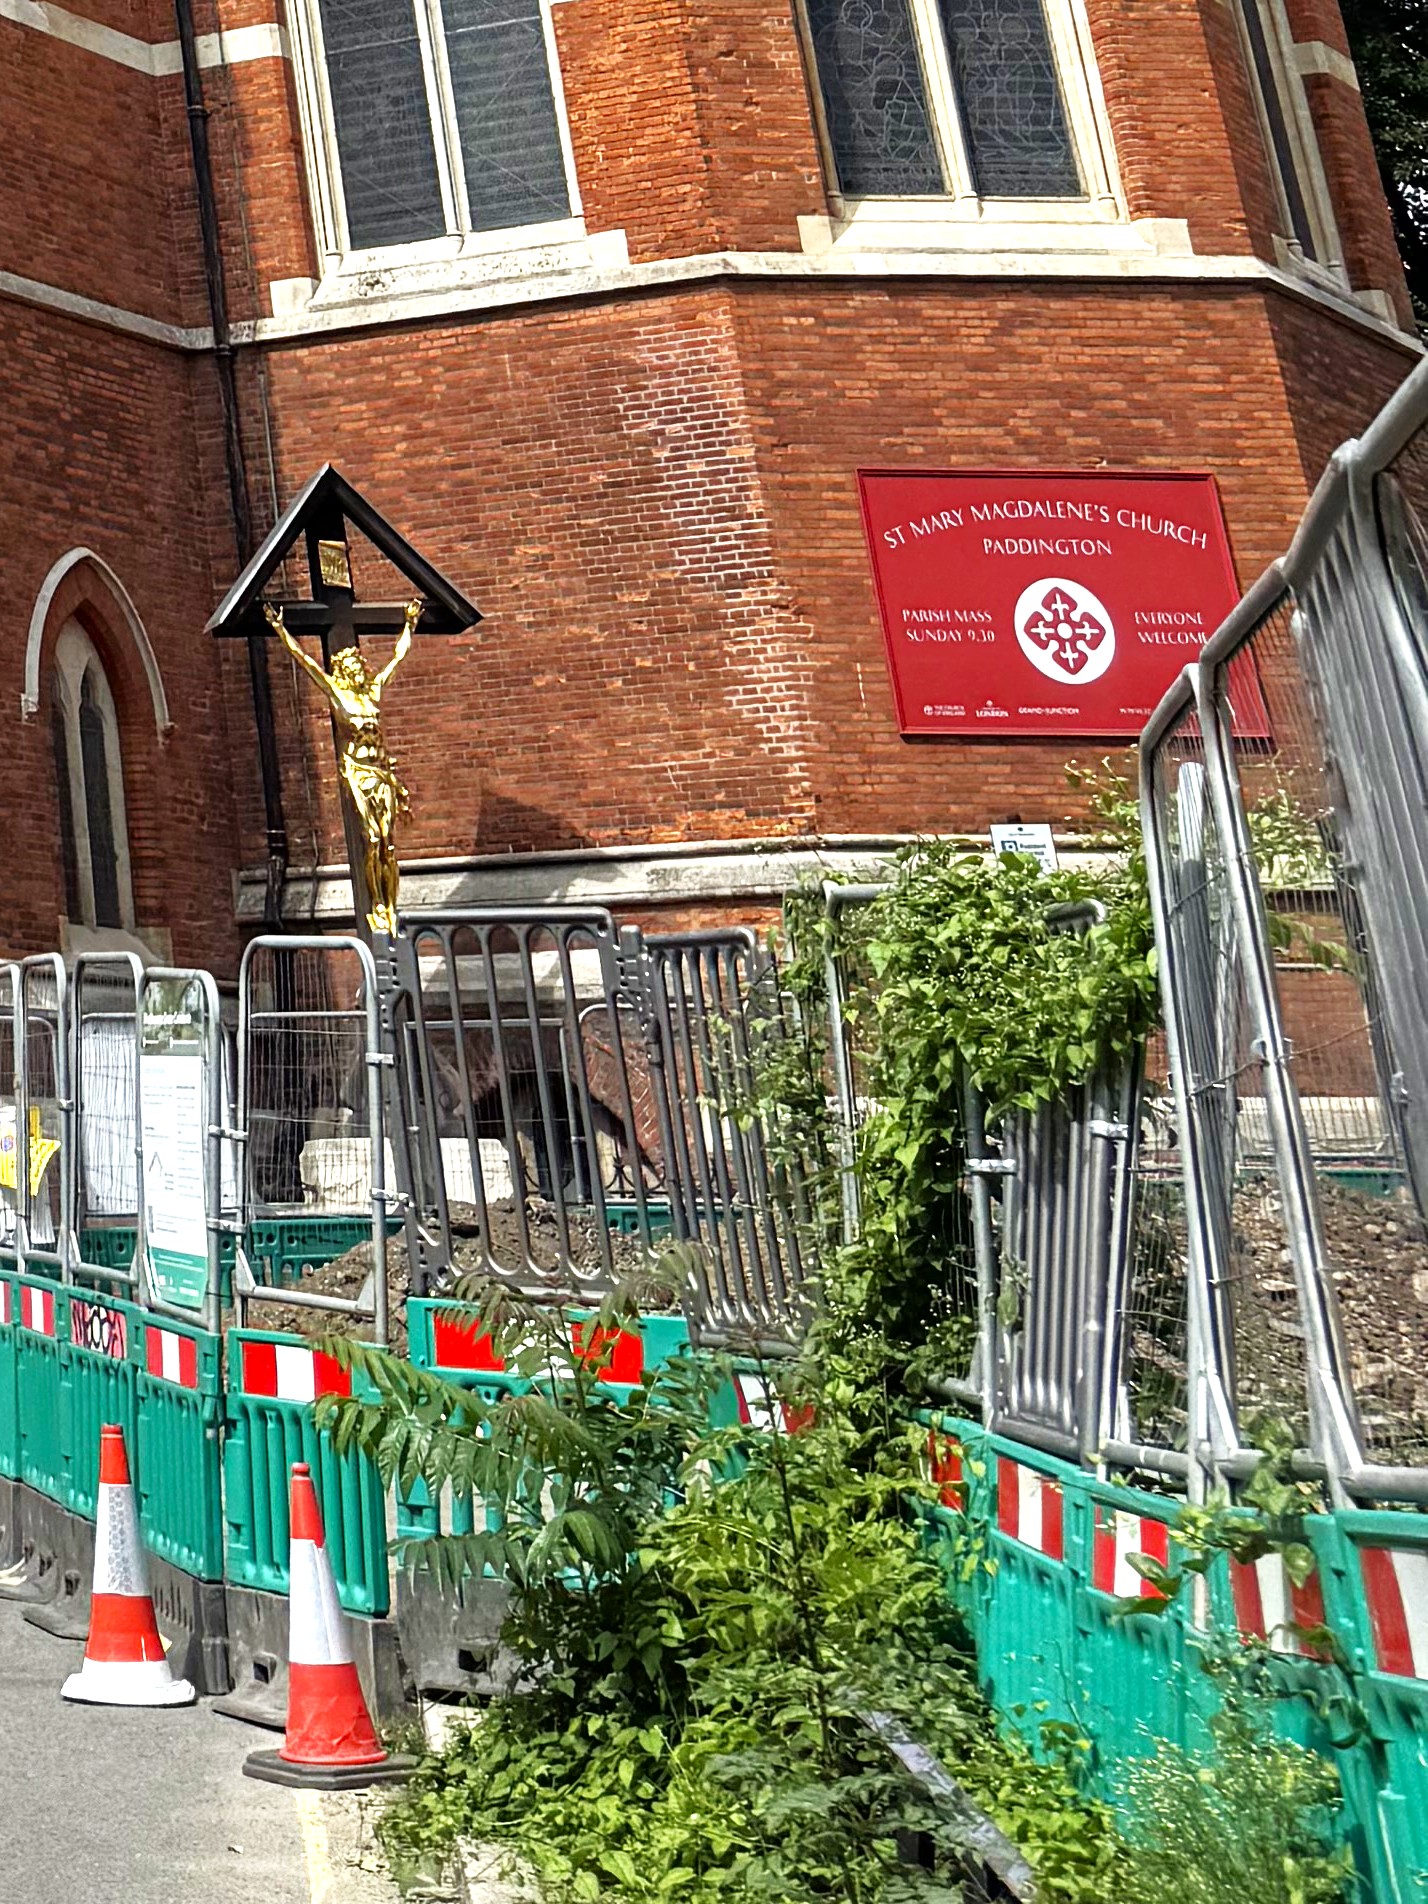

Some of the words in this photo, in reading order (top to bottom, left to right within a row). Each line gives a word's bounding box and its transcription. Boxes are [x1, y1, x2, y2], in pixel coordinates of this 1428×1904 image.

[884, 525, 905, 549] ST
[909, 508, 964, 538] MARY
[970, 500, 1110, 523] MAGDALENE'S
[1116, 509, 1207, 550] CHURCH
[983, 538, 1112, 555] PADDINGTON
[902, 609, 951, 622] PARISH
[954, 609, 992, 623] MASS
[1134, 612, 1202, 625] EVERYONE
[906, 629, 962, 642] SUNDAY
[968, 629, 995, 642] 9.30
[1138, 632, 1208, 645] WELCOME
